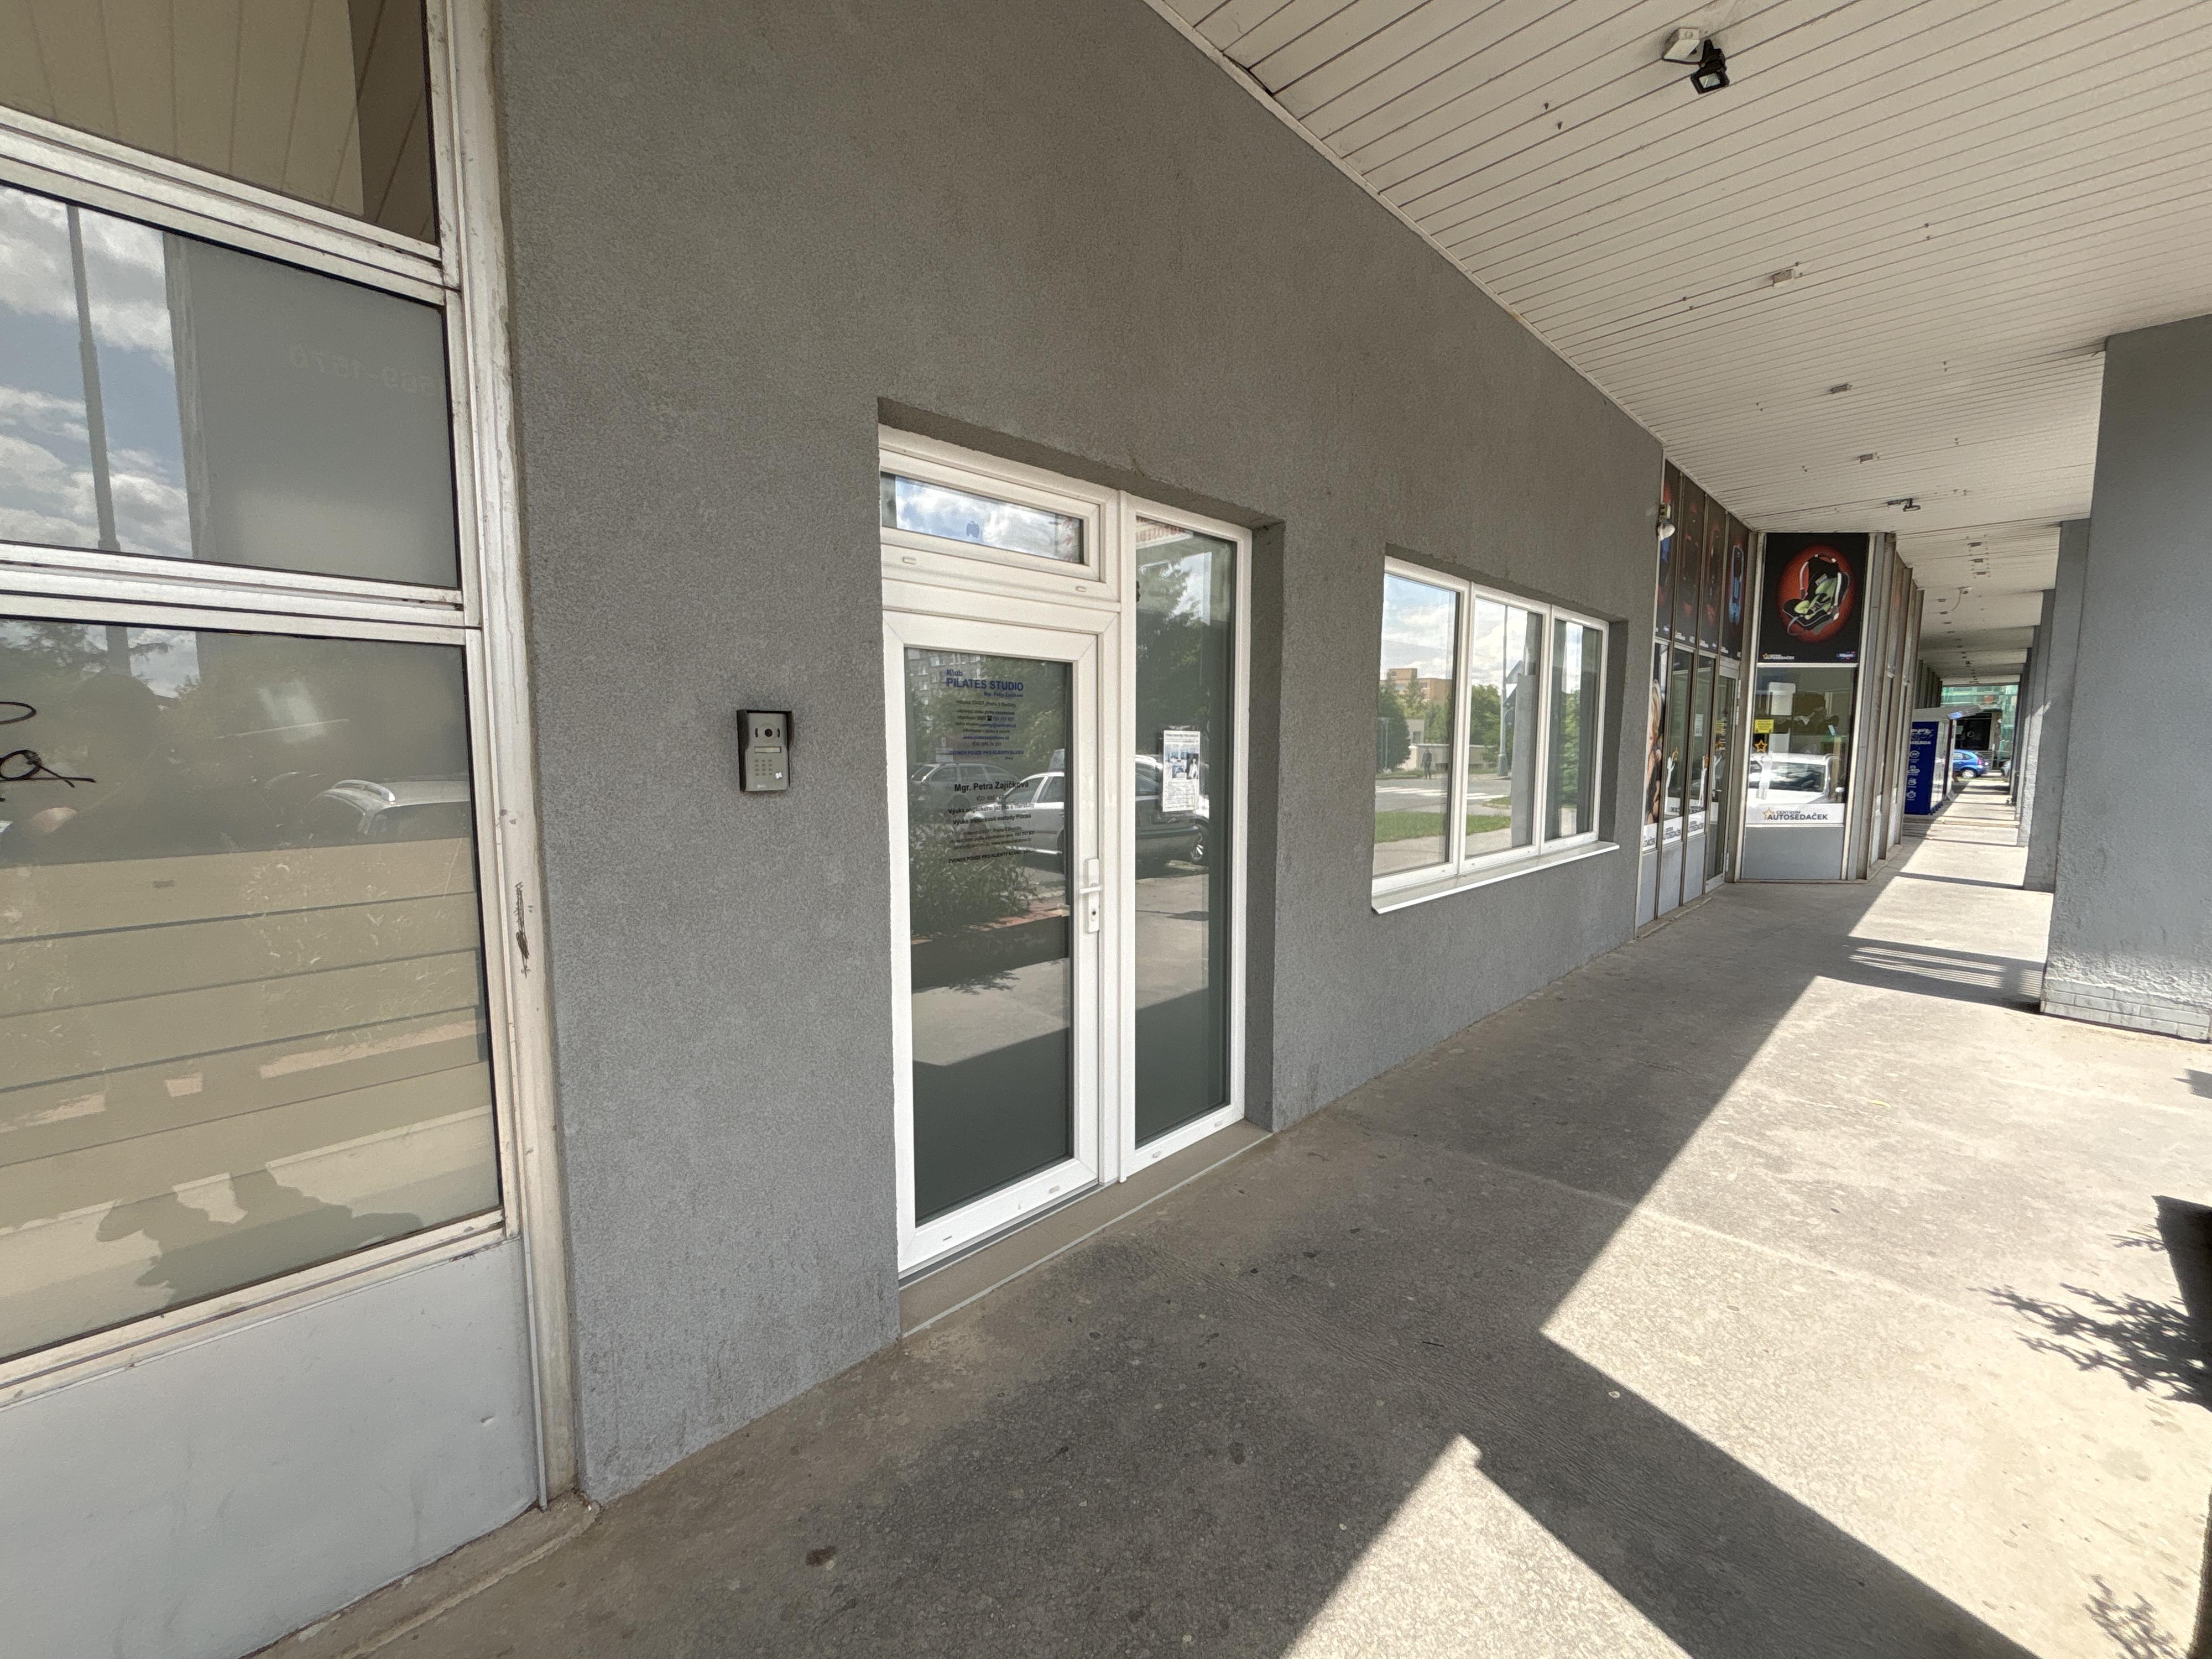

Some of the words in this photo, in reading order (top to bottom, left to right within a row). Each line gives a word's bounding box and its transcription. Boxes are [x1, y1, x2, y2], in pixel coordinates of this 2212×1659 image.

[947, 678, 987, 689] PILATES
[990, 680, 1024, 691] STUDIO
[954, 784, 972, 793] Mgr.
[973, 782, 993, 791] Petra
